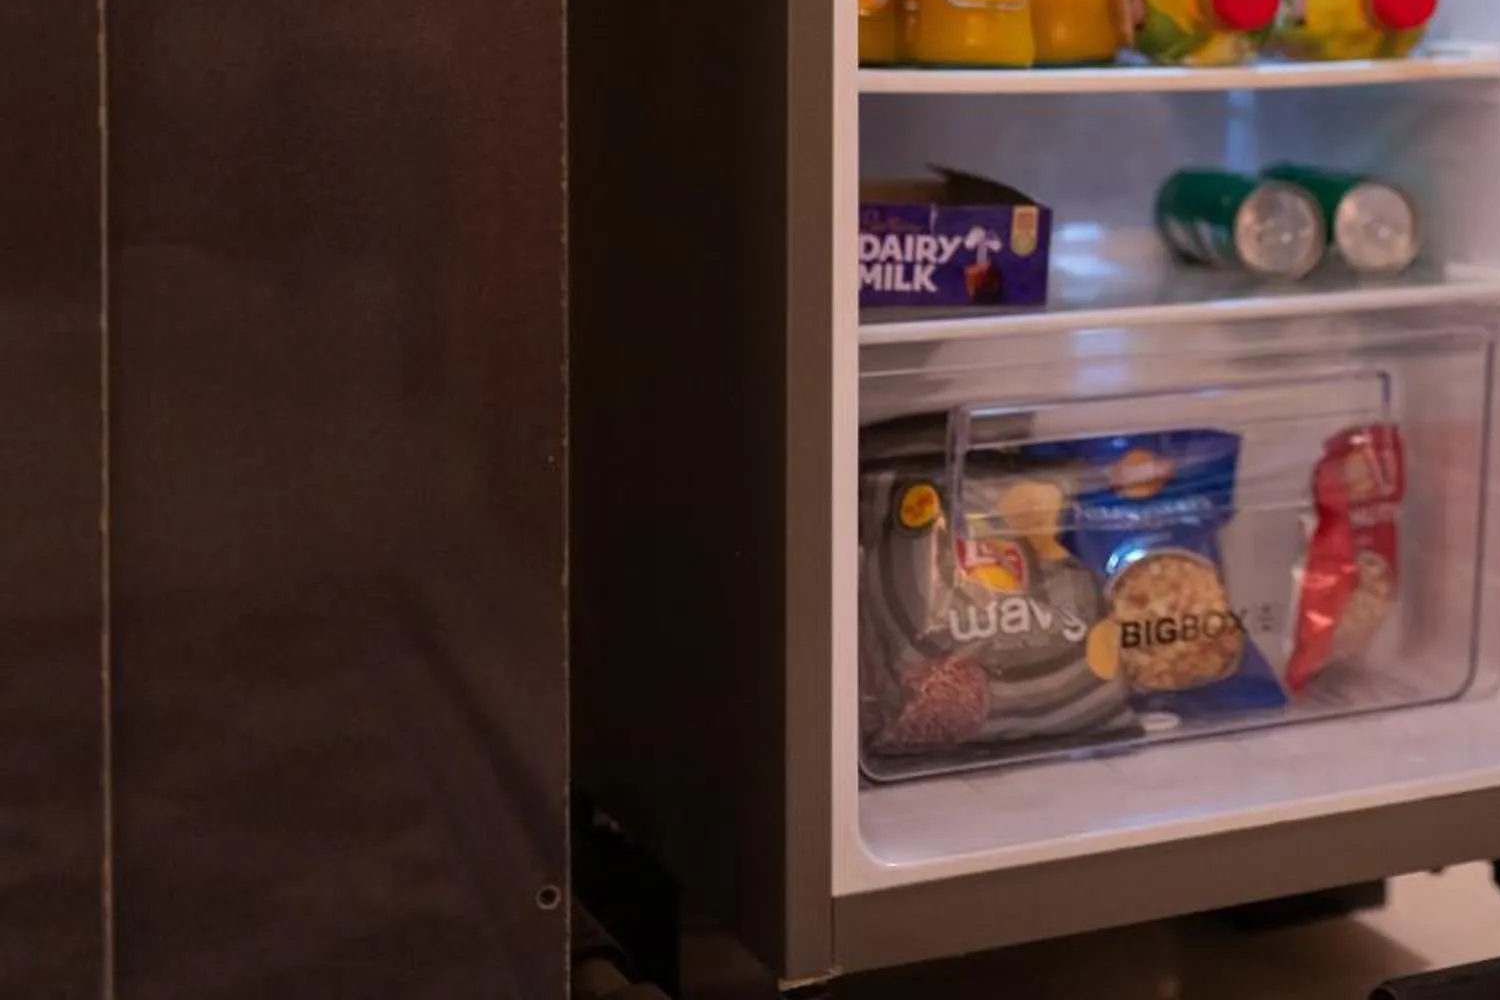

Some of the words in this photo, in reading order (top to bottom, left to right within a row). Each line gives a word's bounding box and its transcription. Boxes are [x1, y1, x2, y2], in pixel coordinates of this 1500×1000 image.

[858, 234, 964, 264] DAIRY
[858, 263, 939, 293] MILK
[1120, 610, 1248, 649] BIGBOX
